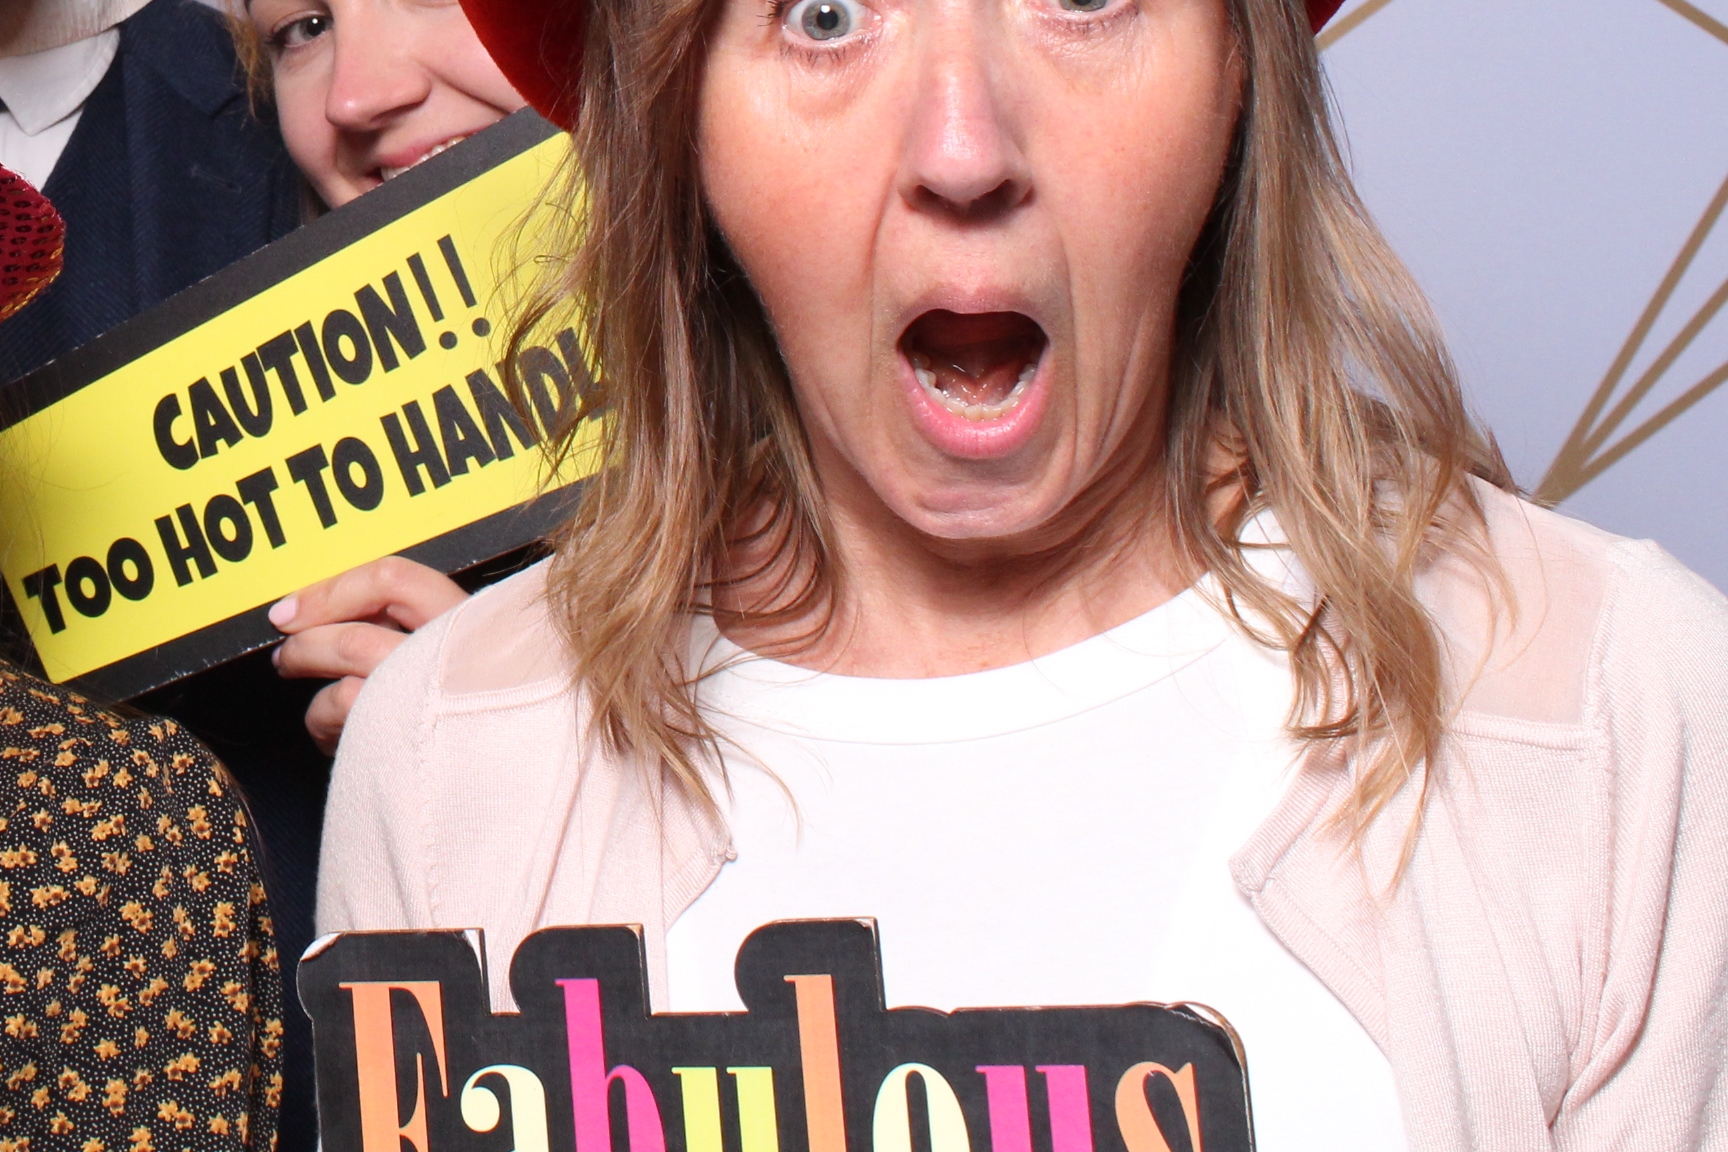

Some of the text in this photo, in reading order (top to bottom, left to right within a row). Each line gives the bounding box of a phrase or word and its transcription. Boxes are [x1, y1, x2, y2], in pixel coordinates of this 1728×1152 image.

[24, 327, 610, 636] TOO HOT TO HANDL
[153, 234, 491, 471] CAUTION!!
